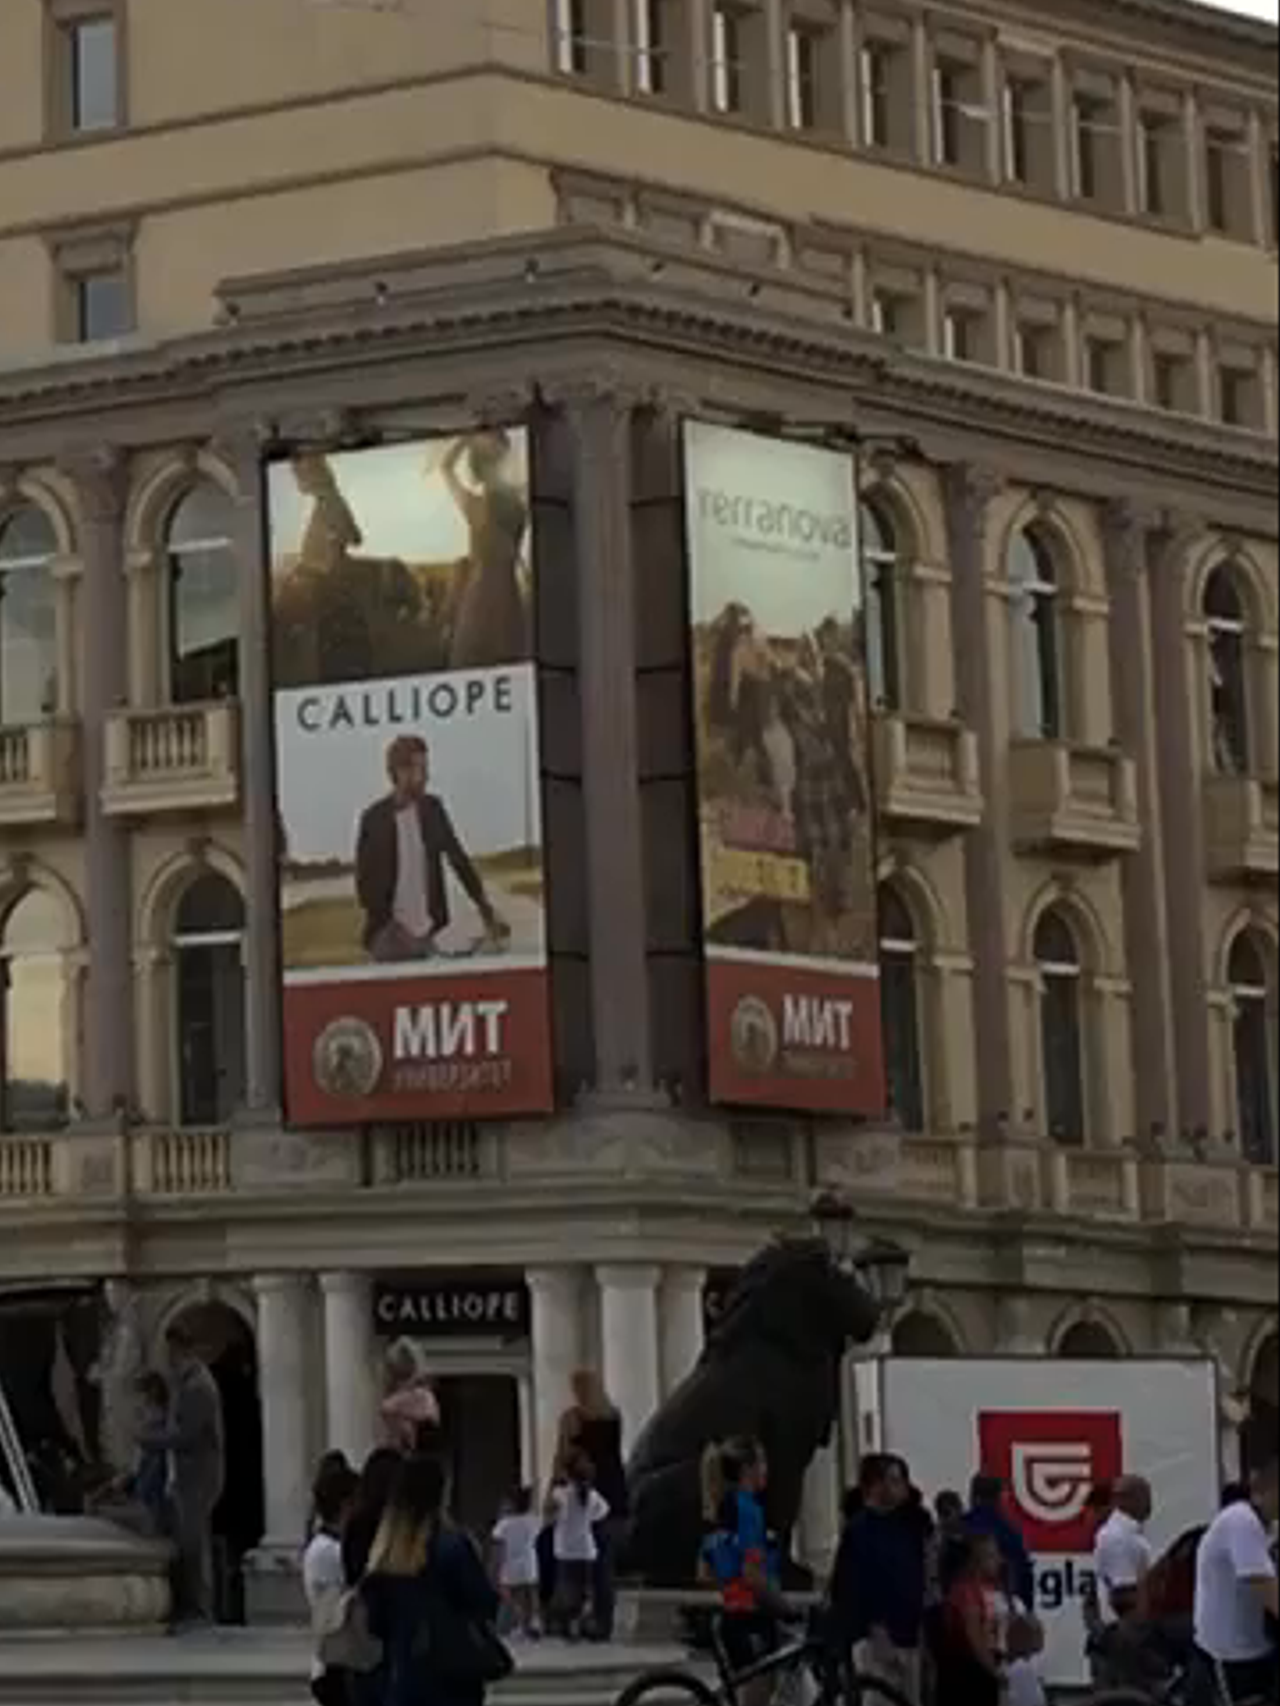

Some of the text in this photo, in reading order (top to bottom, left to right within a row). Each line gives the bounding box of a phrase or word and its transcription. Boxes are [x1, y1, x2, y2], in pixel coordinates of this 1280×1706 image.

[297, 676, 512, 732] CALLIOPE
[393, 999, 508, 1060] МИТ
[782, 993, 853, 1052] МИТ
[376, 1290, 519, 1323] CALLIOPE
